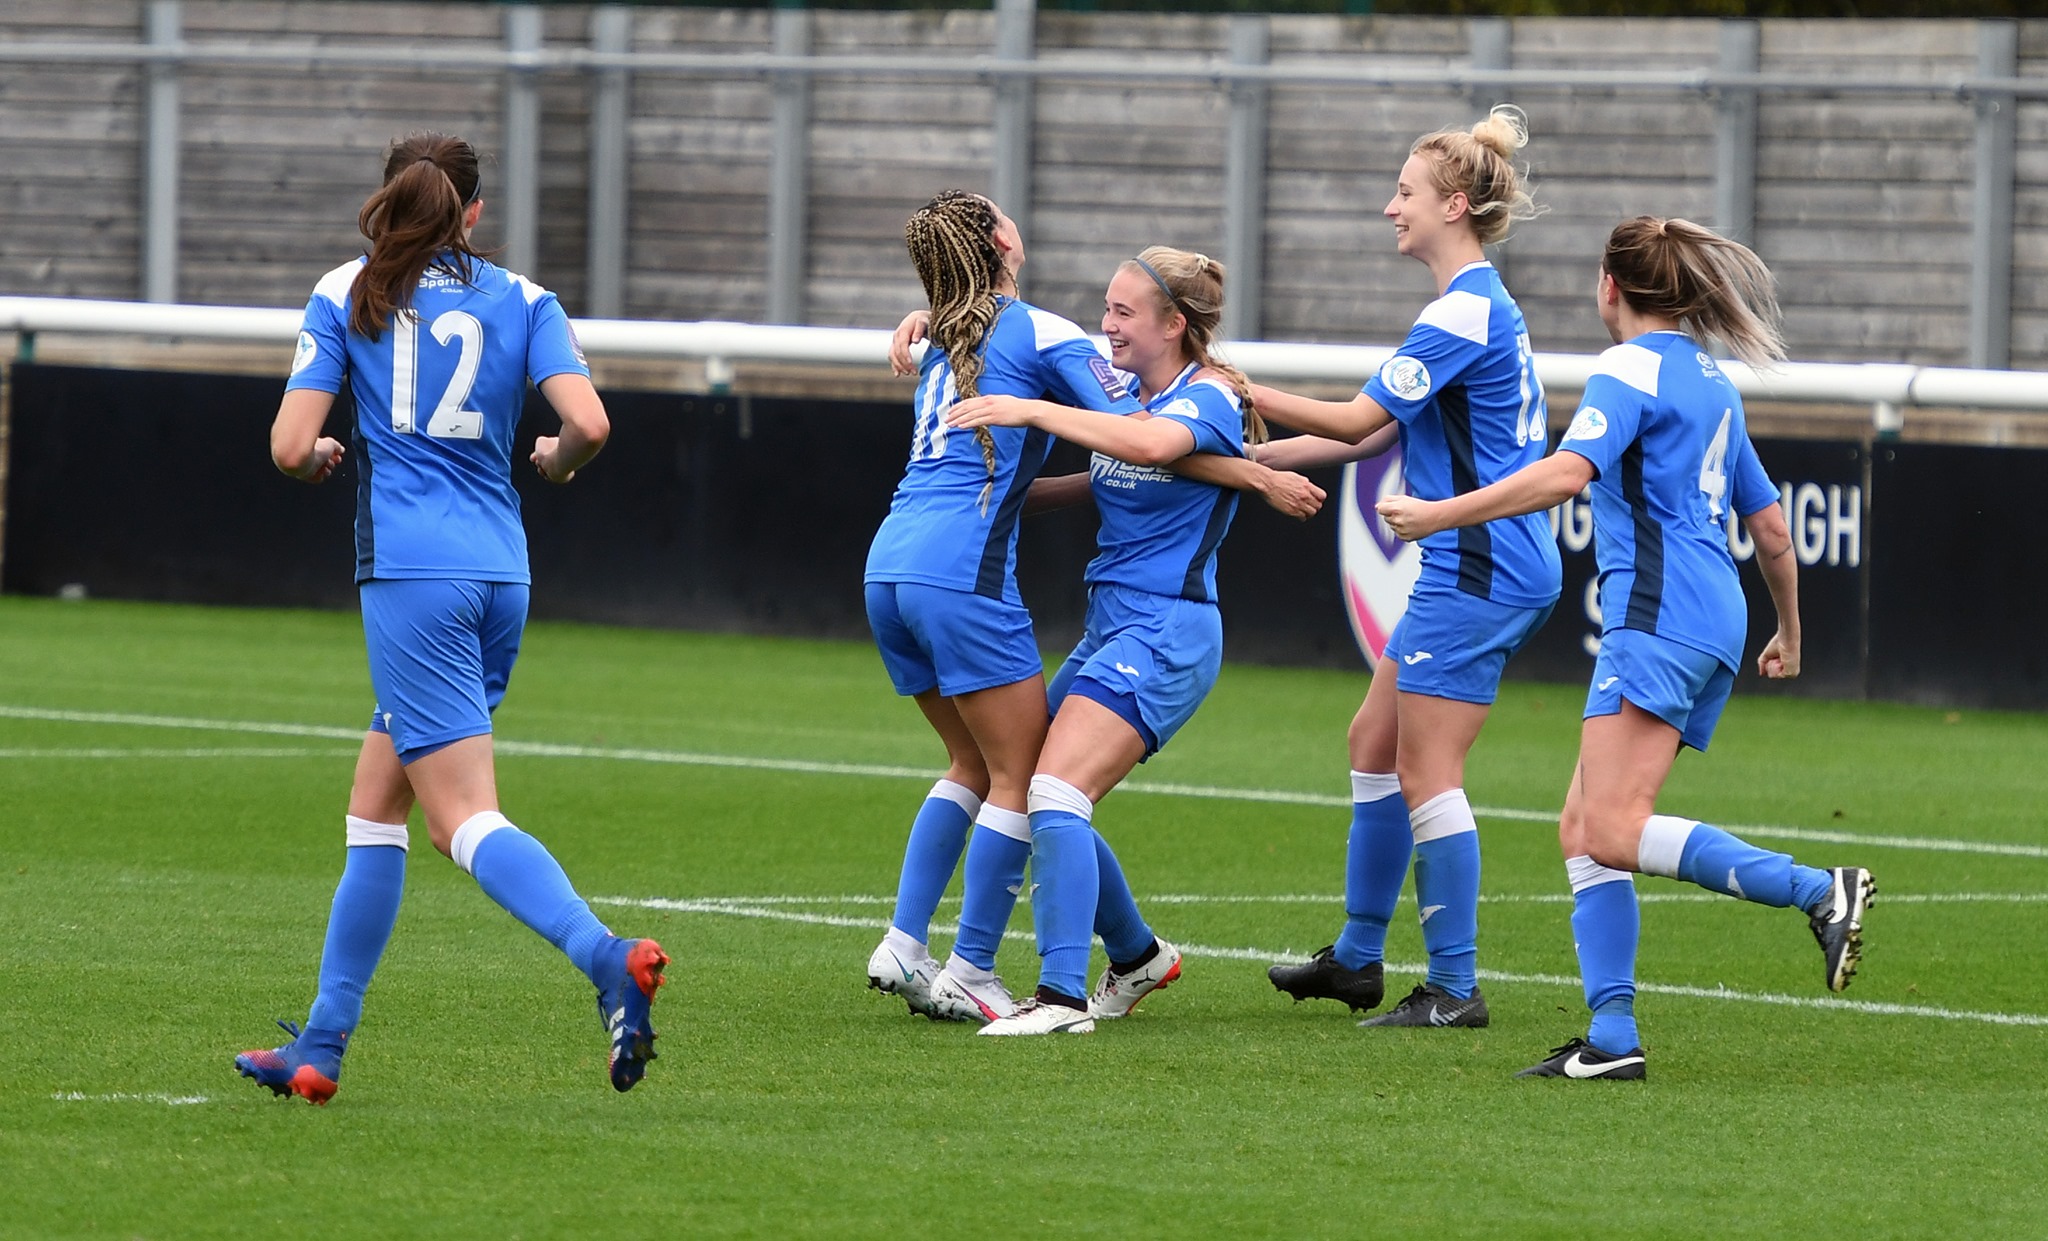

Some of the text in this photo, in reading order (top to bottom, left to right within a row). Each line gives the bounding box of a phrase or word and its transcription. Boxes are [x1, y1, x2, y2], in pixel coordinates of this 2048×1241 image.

[418, 277, 463, 290] Sports
[392, 308, 483, 439] 12
[909, 362, 957, 462] 11
[1102, 478, 1137, 490] .co.uk
[1113, 469, 1174, 483] MANIAC
[1699, 407, 1732, 525] 4
